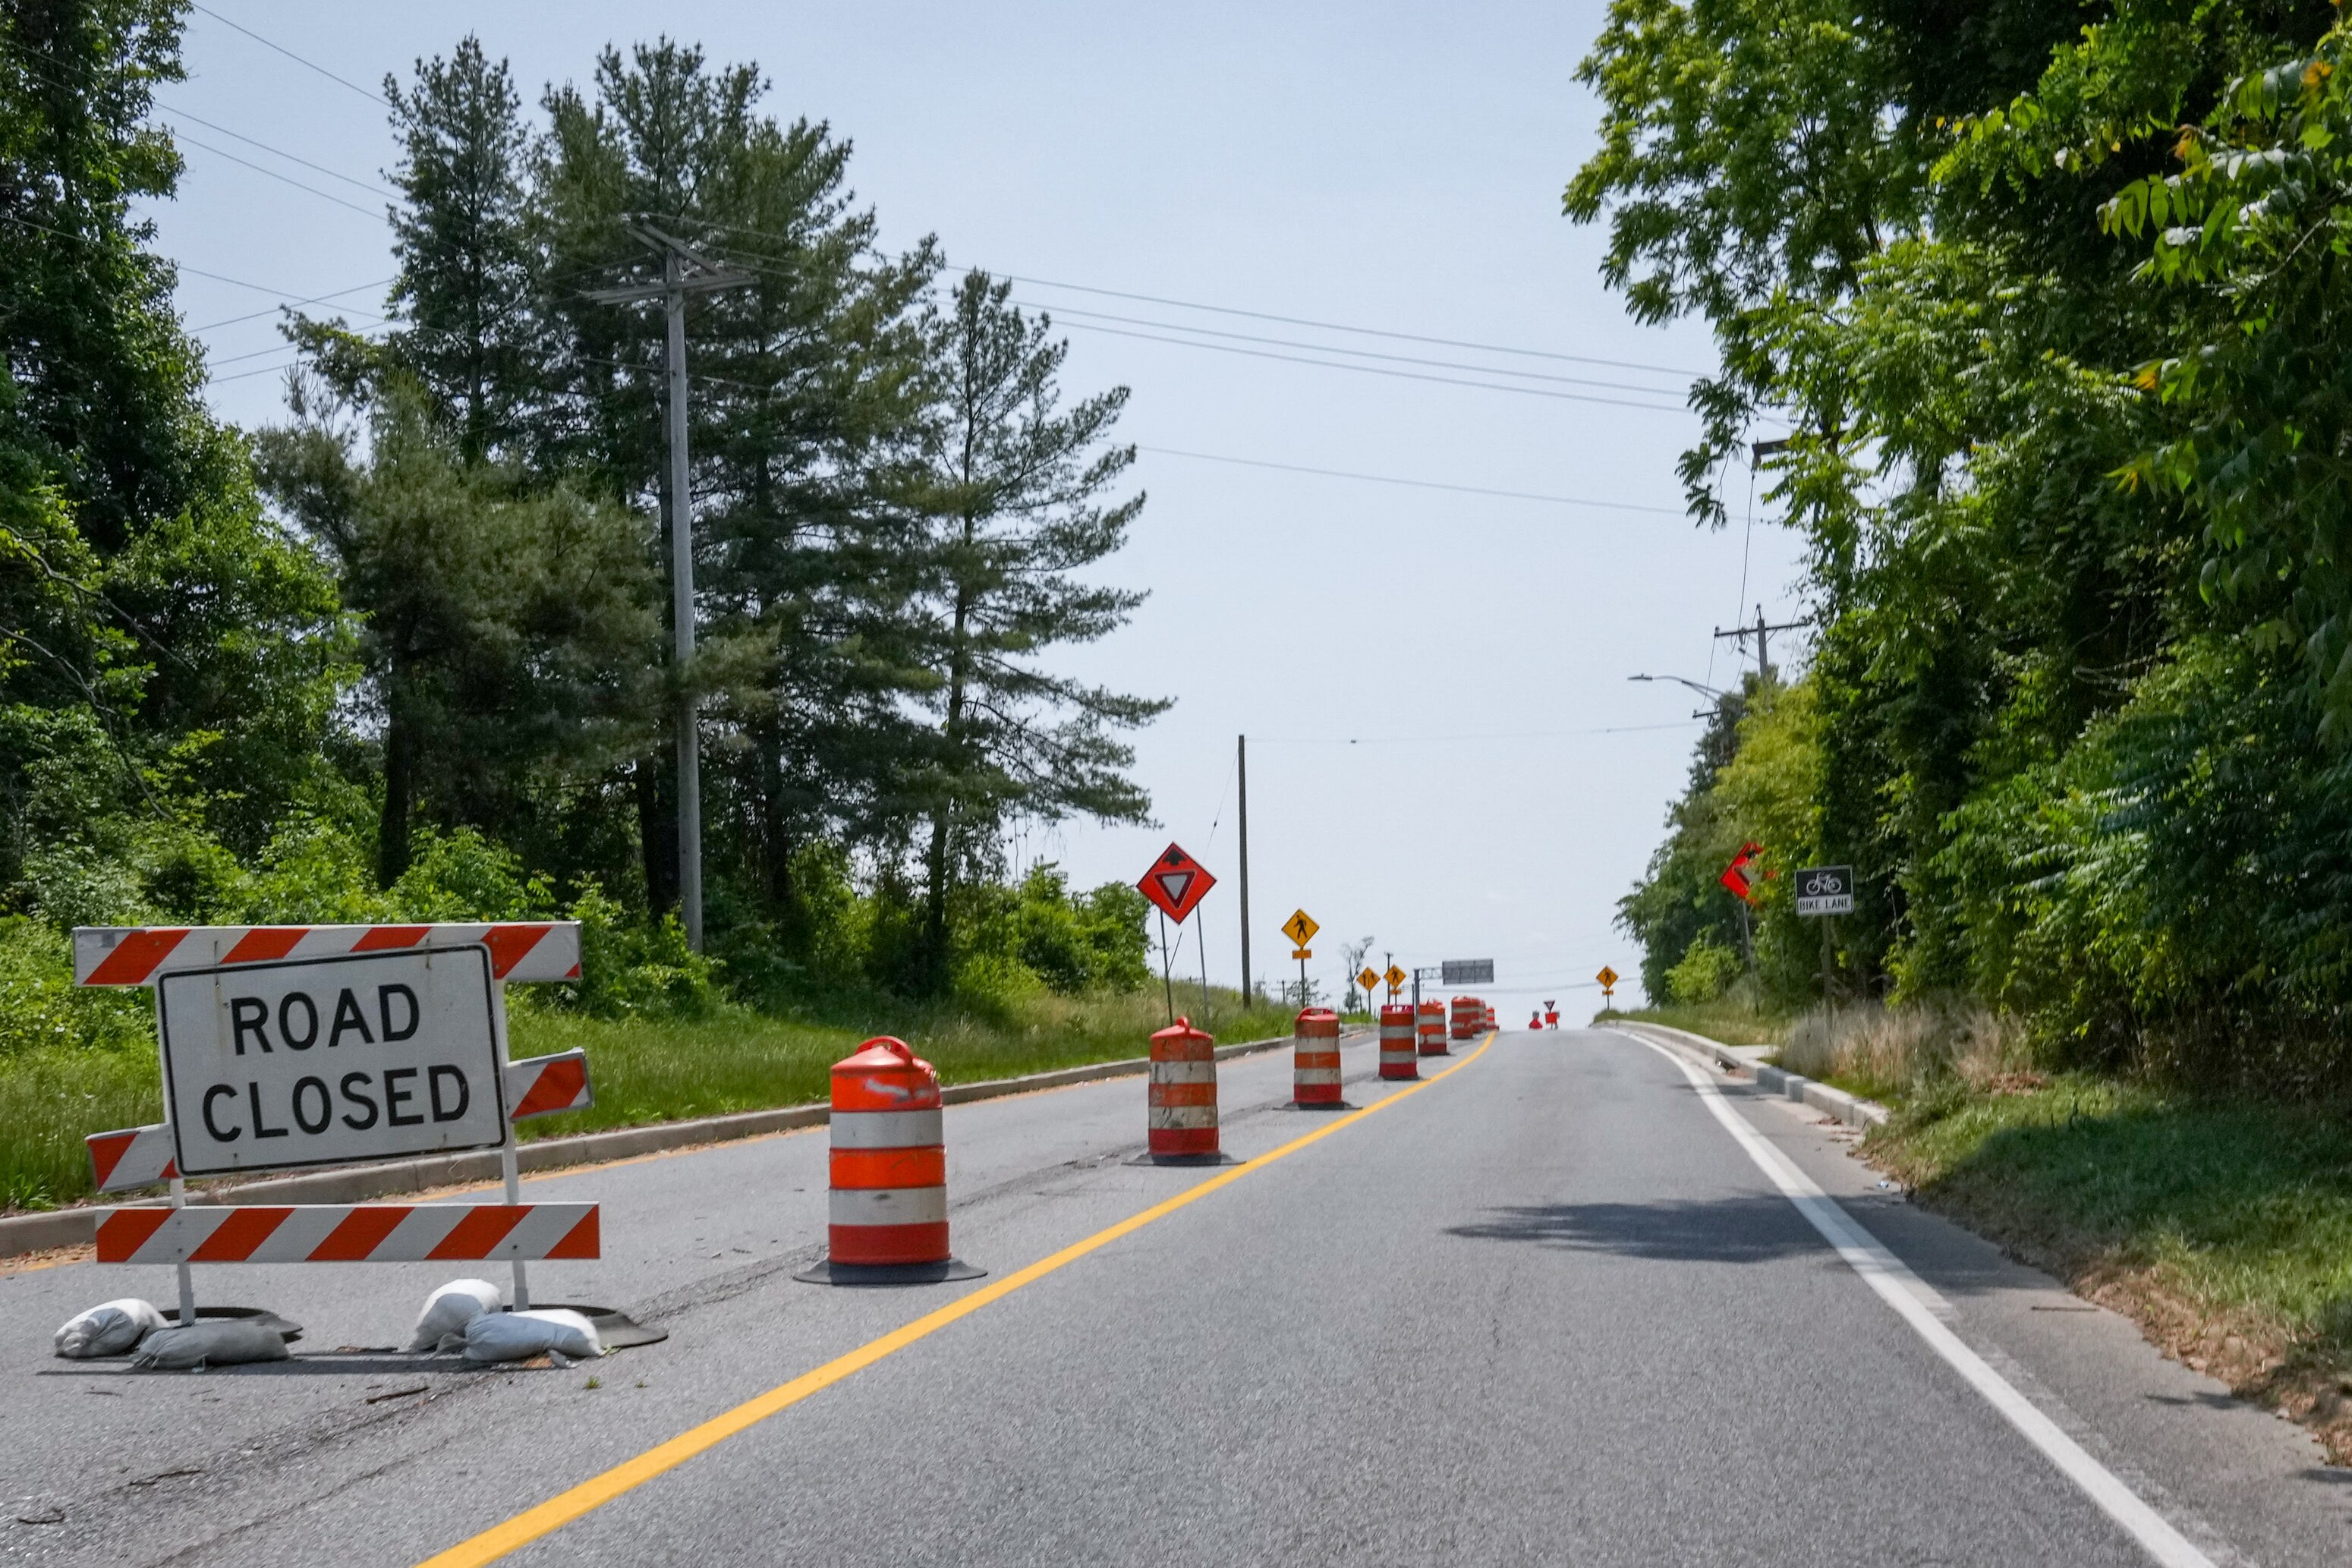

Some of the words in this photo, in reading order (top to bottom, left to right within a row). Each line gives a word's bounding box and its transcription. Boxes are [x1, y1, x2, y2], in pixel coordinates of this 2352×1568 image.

[1799, 900, 1819, 912] BIKE
[1826, 898, 1850, 909] LANE
[231, 984, 420, 1055] ROAD
[202, 1064, 470, 1142] CLOSED
